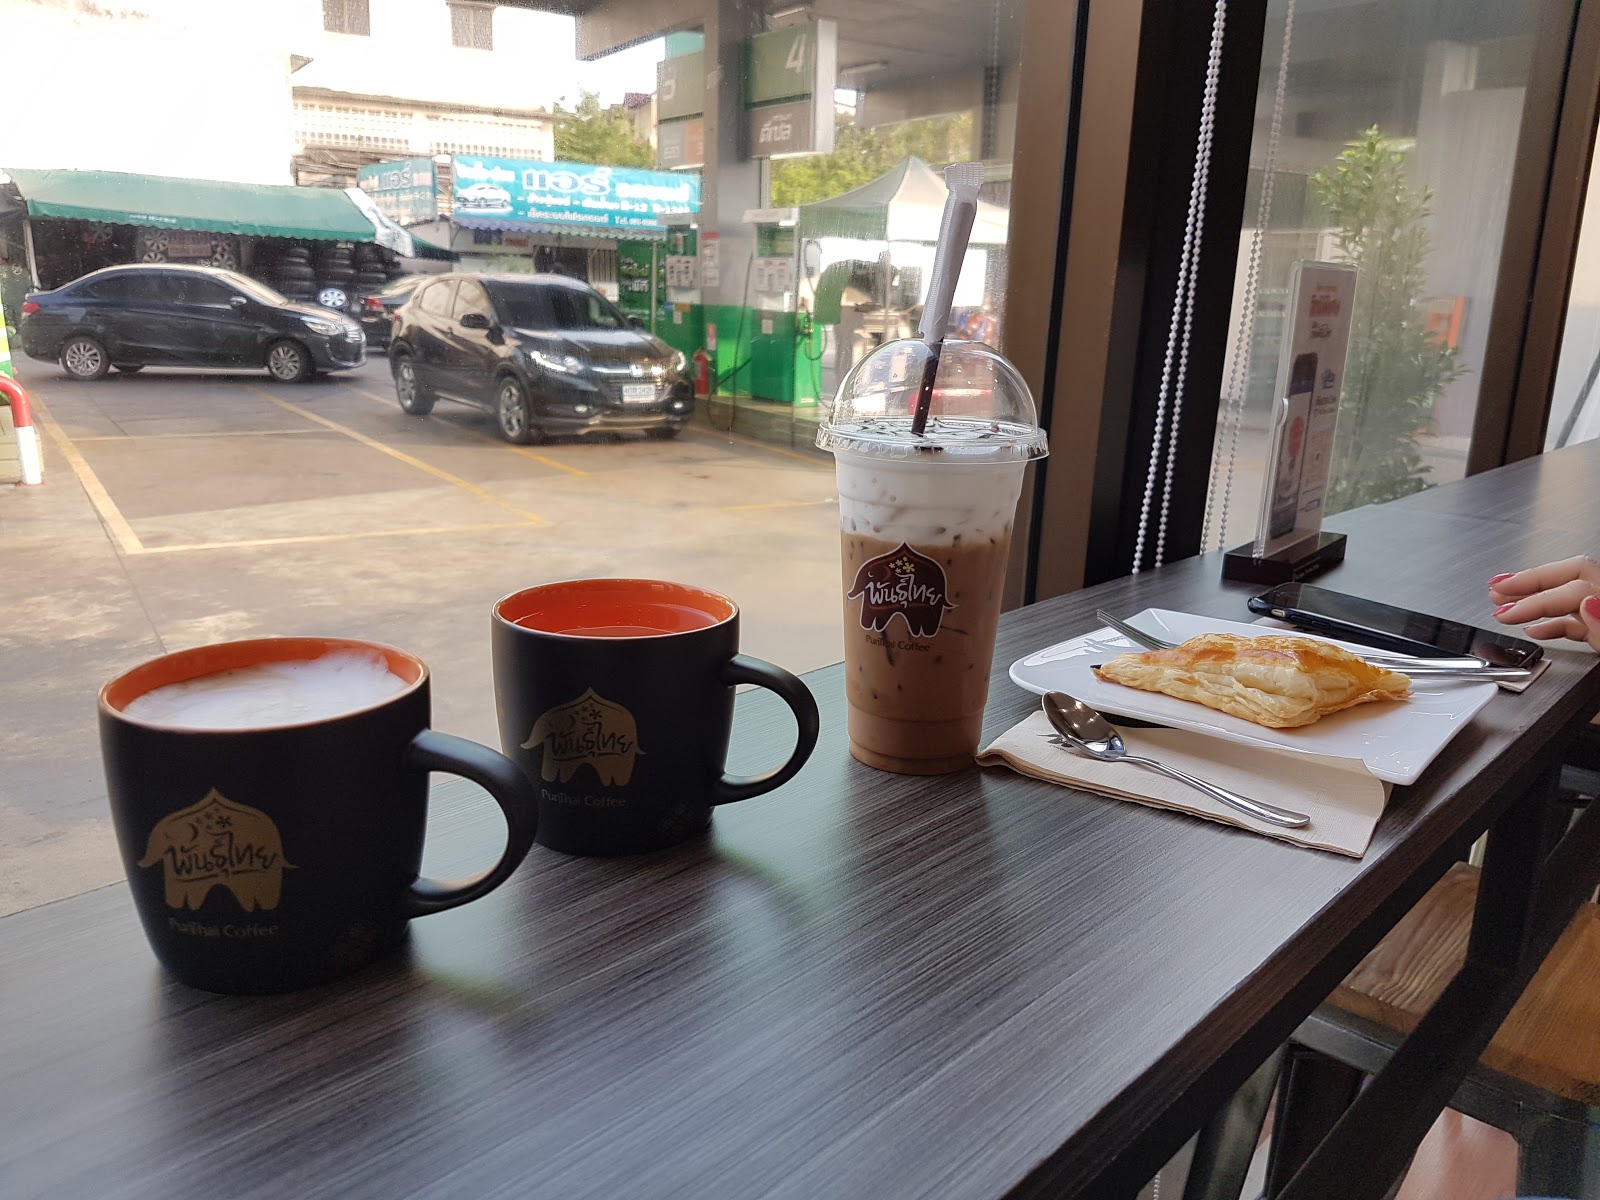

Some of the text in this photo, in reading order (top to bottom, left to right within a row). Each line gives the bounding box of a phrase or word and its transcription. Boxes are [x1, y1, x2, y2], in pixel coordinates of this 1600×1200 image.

[784, 33, 807, 73] 4
[522, 167, 612, 196] แอร์
[865, 572, 943, 609] พันธุ์ไทย
[898, 641, 931, 652] Coffee
[546, 721, 634, 758] พันธุ์ไทย
[584, 795, 626, 807] Coffee
[164, 830, 278, 878] พันธุ์ไทย
[224, 924, 279, 937] Coffee
